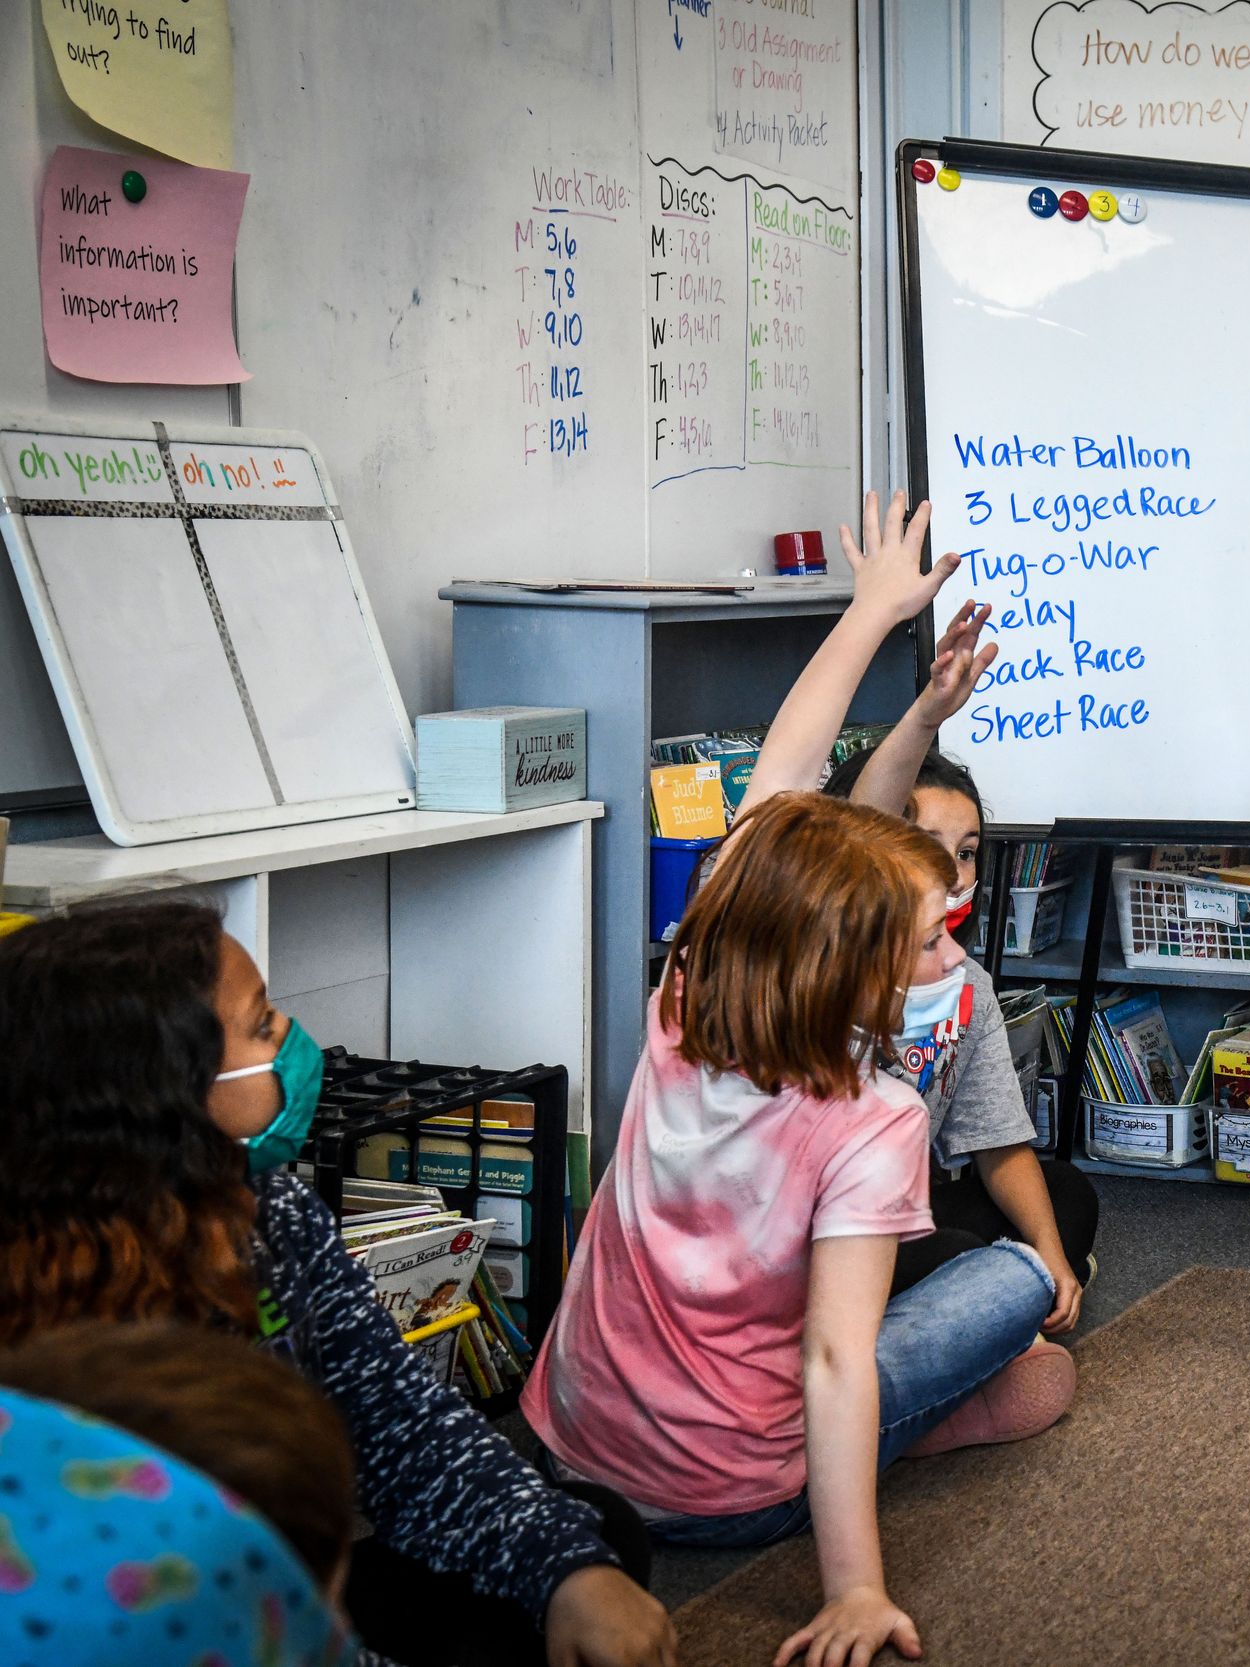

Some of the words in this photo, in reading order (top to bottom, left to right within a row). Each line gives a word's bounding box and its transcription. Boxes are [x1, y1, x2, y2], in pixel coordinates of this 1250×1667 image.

[667, 0, 712, 18] panner
[126, 10, 149, 40] to
[155, 17, 196, 56] find
[732, 20, 758, 53] Old
[763, 26, 842, 72] Assignment
[1082, 29, 1153, 67] How
[1162, 31, 1202, 67] do
[67, 42, 110, 74] out?
[733, 66, 746, 89] or
[752, 60, 803, 113] Drawing
[1075, 98, 1128, 130] use
[733, 110, 784, 163] Activity
[787, 111, 829, 147] Packet
[61, 185, 112, 217] What
[532, 165, 586, 207] Work
[583, 171, 632, 211] Table:
[659, 175, 716, 217] Discs:
[1099, 195, 1111, 213] 3
[1126, 196, 1141, 218] 4
[753, 191, 790, 237] Read
[792, 210, 812, 239] on
[814, 207, 852, 252] Floor:
[59, 235, 175, 275] information
[183, 250, 199, 277] is
[546, 222, 577, 260] 5,6
[651, 225, 673, 258] M:
[678, 229, 711, 266] 7,8,9
[751, 237, 769, 271] M:
[62, 288, 179, 324] important?
[544, 267, 575, 308] 7,8
[650, 272, 674, 302] T:
[751, 277, 769, 307] T:
[545, 311, 583, 349] 9,10
[651, 316, 673, 349] W:
[551, 366, 583, 402] 11,12
[650, 361, 675, 403] Th:
[550, 412, 589, 457] 13,14
[656, 418, 674, 460] F:
[953, 433, 1066, 470] Water
[1073, 433, 1192, 471] Balloon
[19, 442, 60, 480] oh
[64, 447, 148, 495] yeah!
[183, 452, 216, 487] oh
[220, 457, 266, 490] no!
[964, 490, 993, 526] 3
[1010, 487, 1140, 532] Legged
[1141, 486, 1217, 518] Race
[959, 540, 1160, 598] Tug-o-War
[1073, 640, 1146, 679] Race
[970, 698, 1073, 744] Sheet
[1078, 694, 1150, 733] Race
[515, 739, 520, 756] A
[525, 735, 553, 755] LITTLE
[557, 732, 575, 751] MORE
[515, 752, 577, 788] kindness
[672, 778, 706, 799] Judy
[672, 805, 715, 826] Blume
[1219, 1064, 1234, 1074] The
[1099, 1115, 1158, 1132] Biographies
[422, 1164, 455, 1177] Elephant
[485, 1170, 500, 1180] and
[391, 1260, 414, 1273] Can
[416, 1244, 448, 1263] Read!
[374, 1286, 412, 1311] irt
